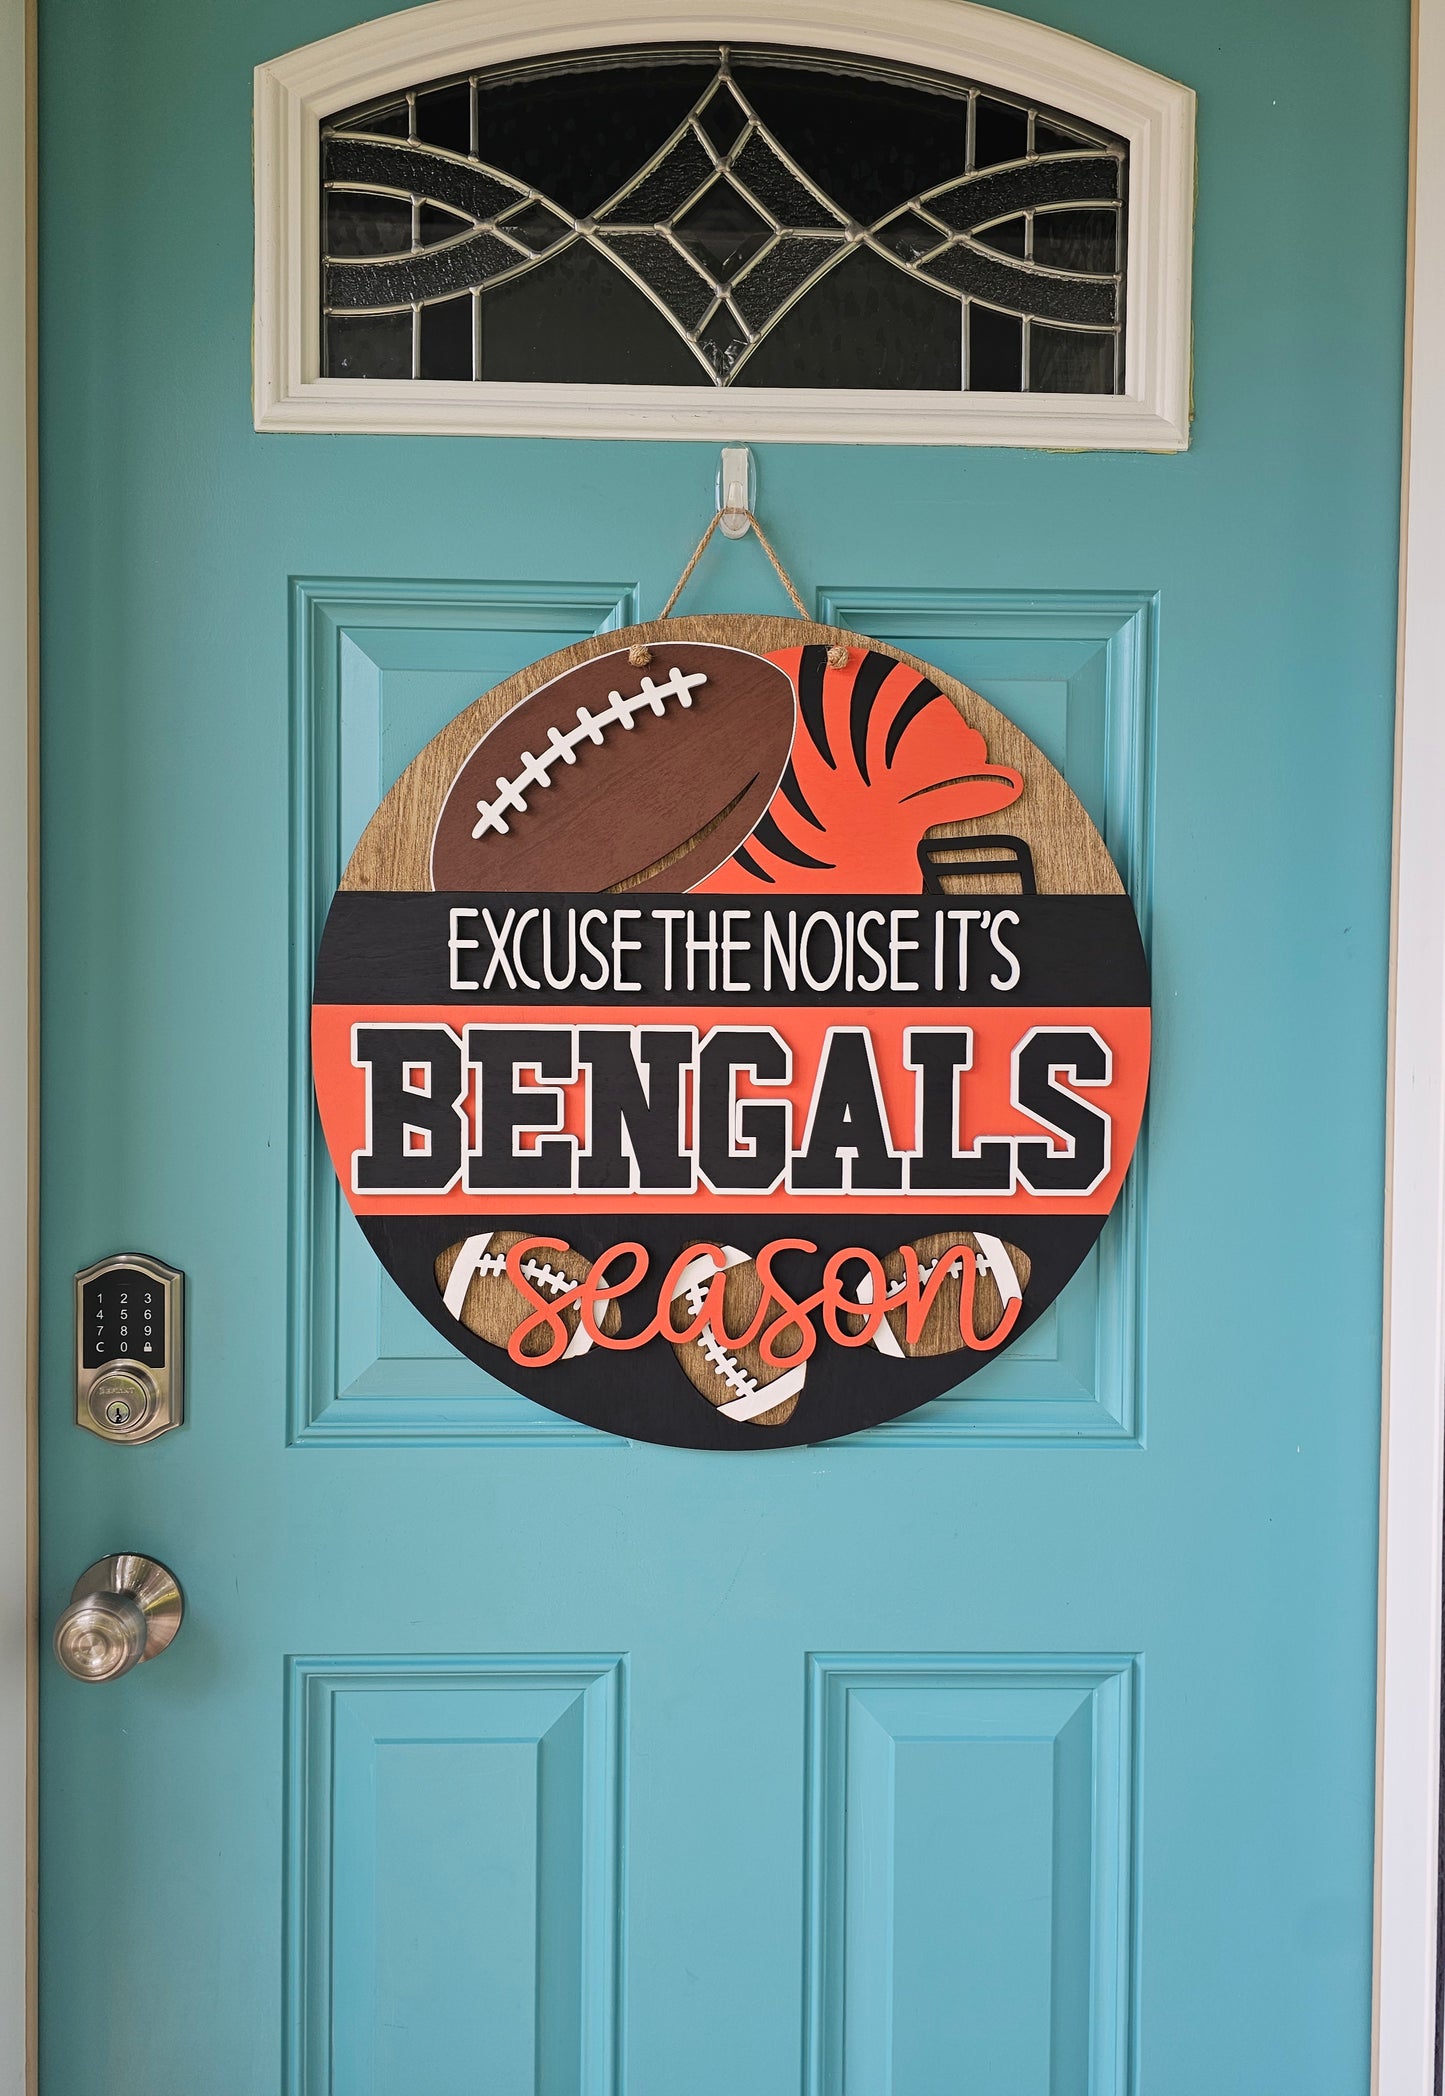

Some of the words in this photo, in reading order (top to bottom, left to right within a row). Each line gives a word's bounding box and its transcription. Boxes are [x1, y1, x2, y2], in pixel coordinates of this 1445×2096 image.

[448, 908, 642, 991] EXCUSE
[652, 909, 751, 991] THE
[764, 910, 920, 992] NOISE
[935, 910, 1021, 992] IT'S
[351, 1022, 1113, 1196] BENGALS
[97, 1293, 103, 1304] 1
[120, 1293, 128, 1304] 2
[144, 1293, 152, 1304] 3
[506, 1237, 1022, 1369] season
[96, 1309, 104, 1320] 4
[120, 1309, 128, 1320] 5
[144, 1309, 152, 1320] 6
[96, 1325, 104, 1336] 7
[120, 1325, 128, 1337] 8
[144, 1325, 152, 1337] 9
[96, 1341, 105, 1353] C
[120, 1341, 128, 1353] 0
